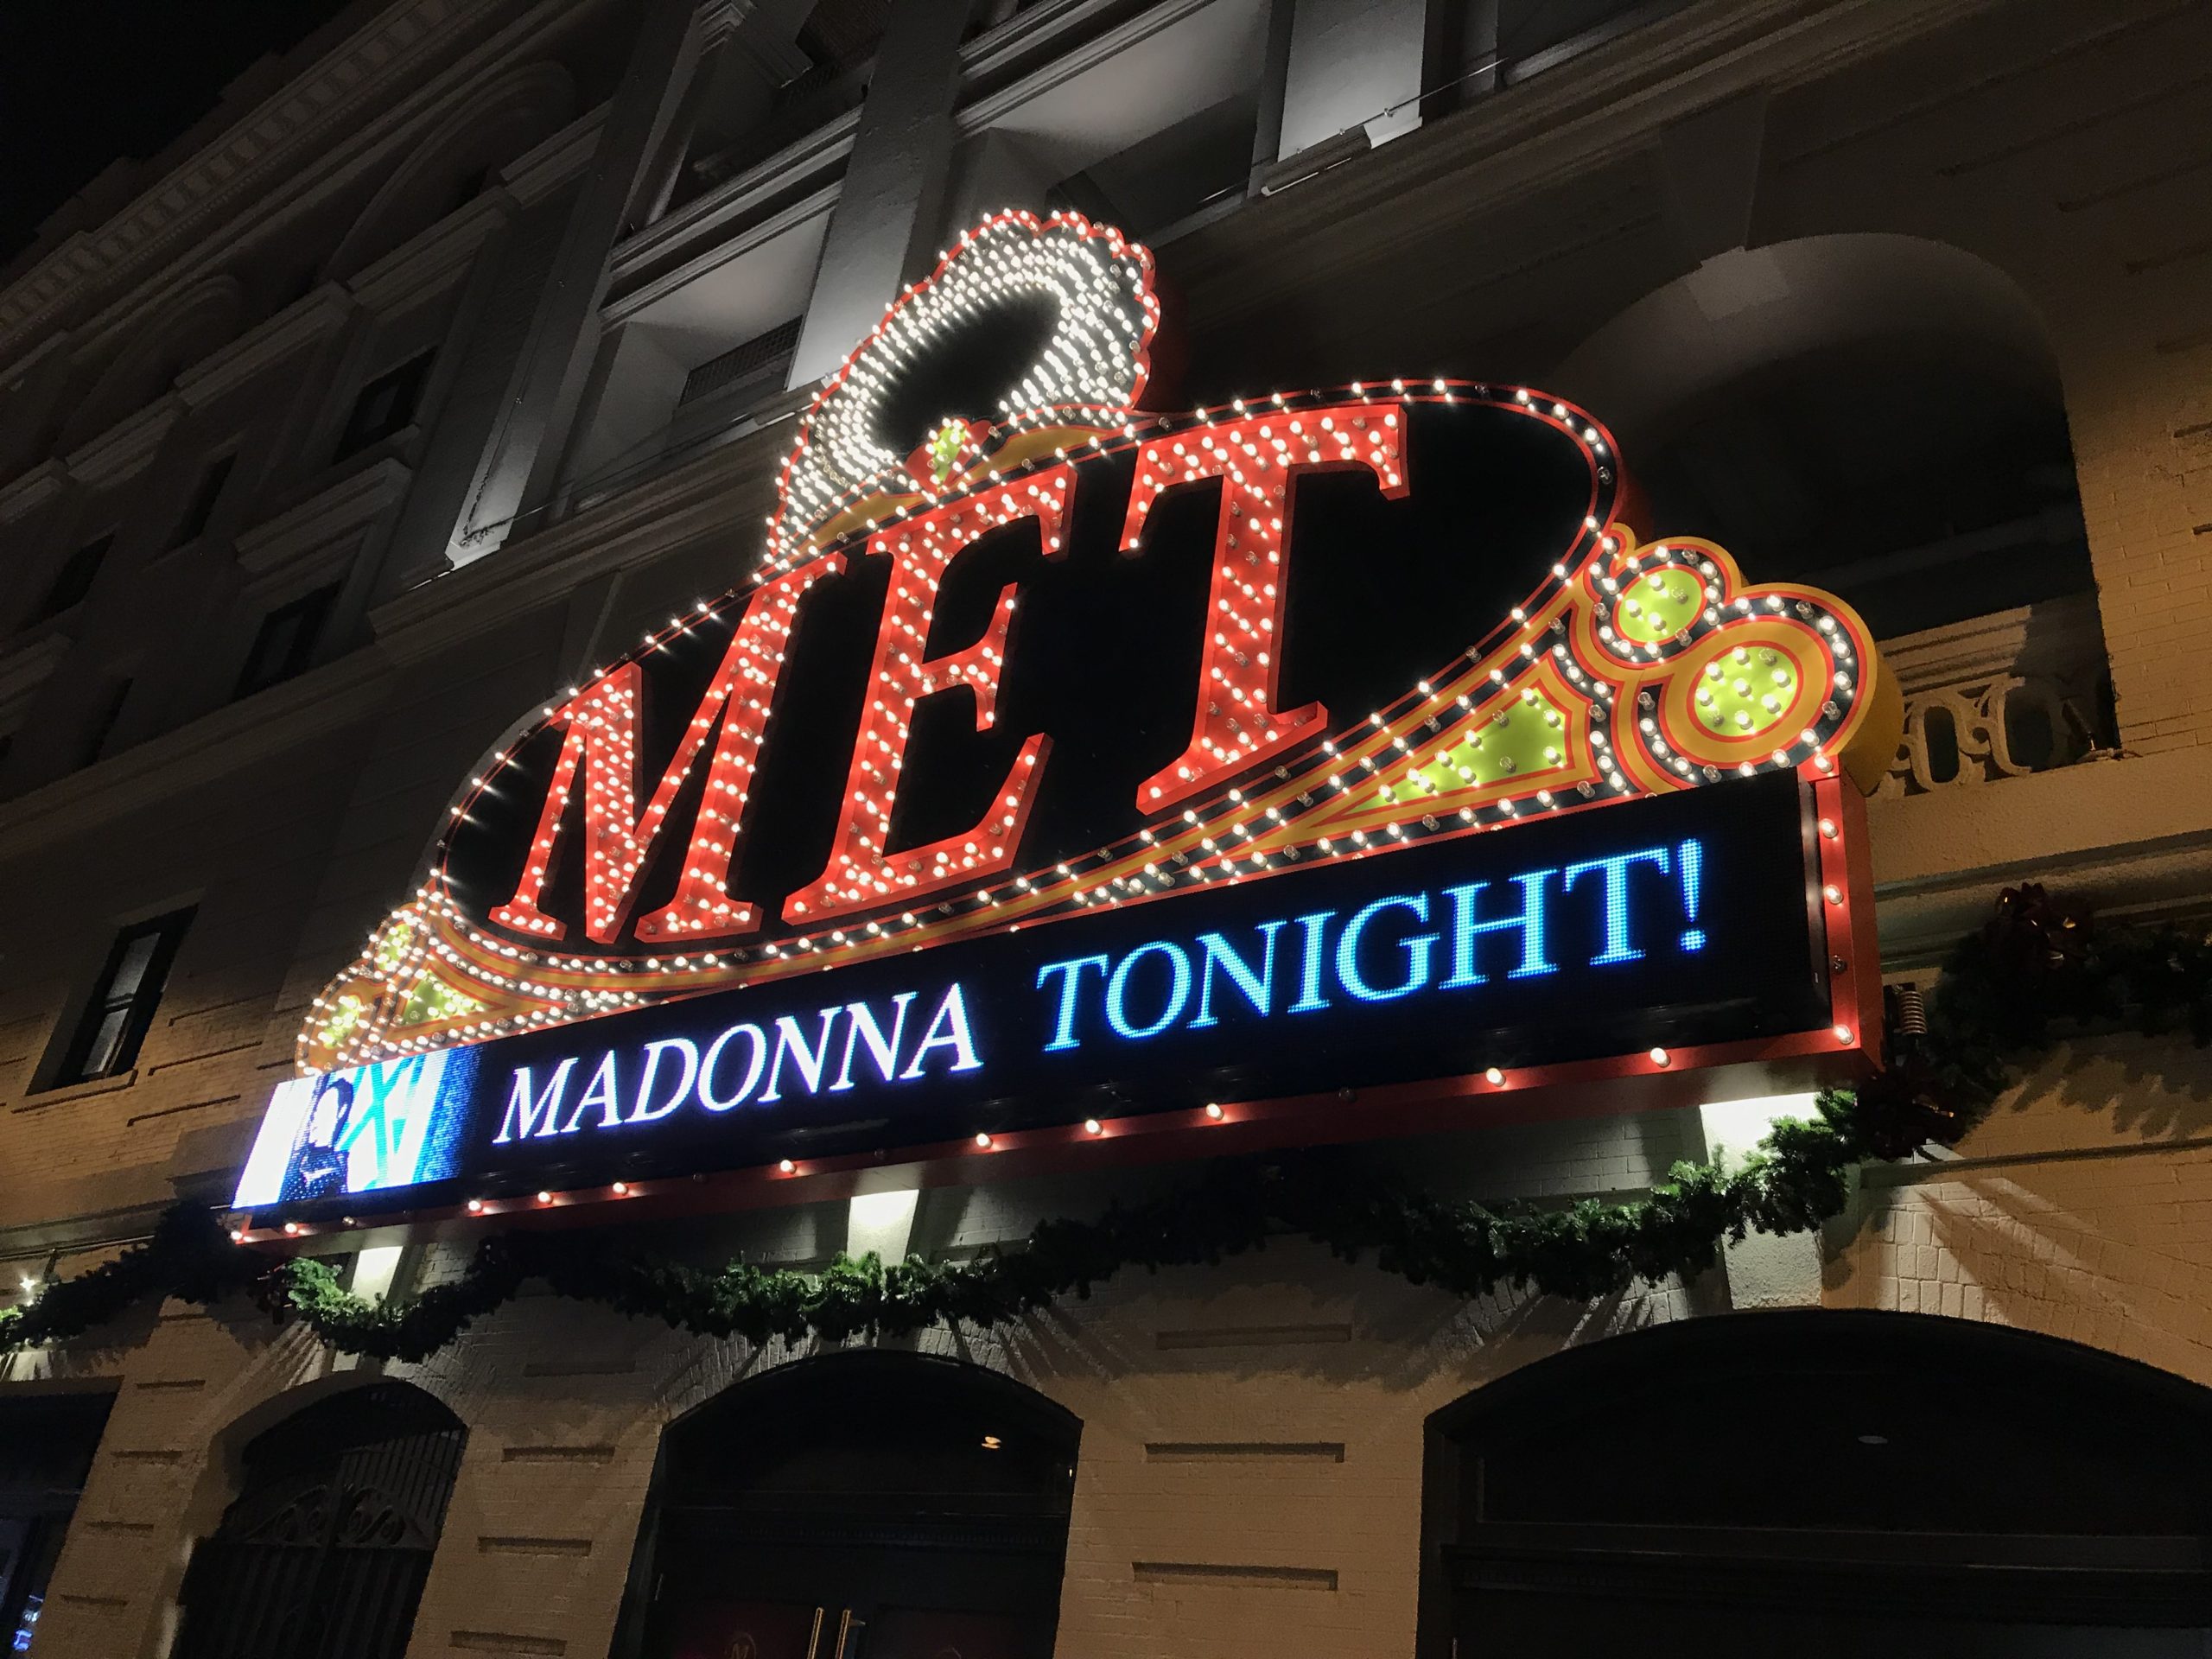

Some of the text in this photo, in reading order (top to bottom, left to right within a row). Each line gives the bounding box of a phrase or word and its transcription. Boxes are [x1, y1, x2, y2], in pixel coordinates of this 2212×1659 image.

[489, 404, 1410, 944] MET
[493, 837, 1707, 1144] MADONNA TONIGHT!
